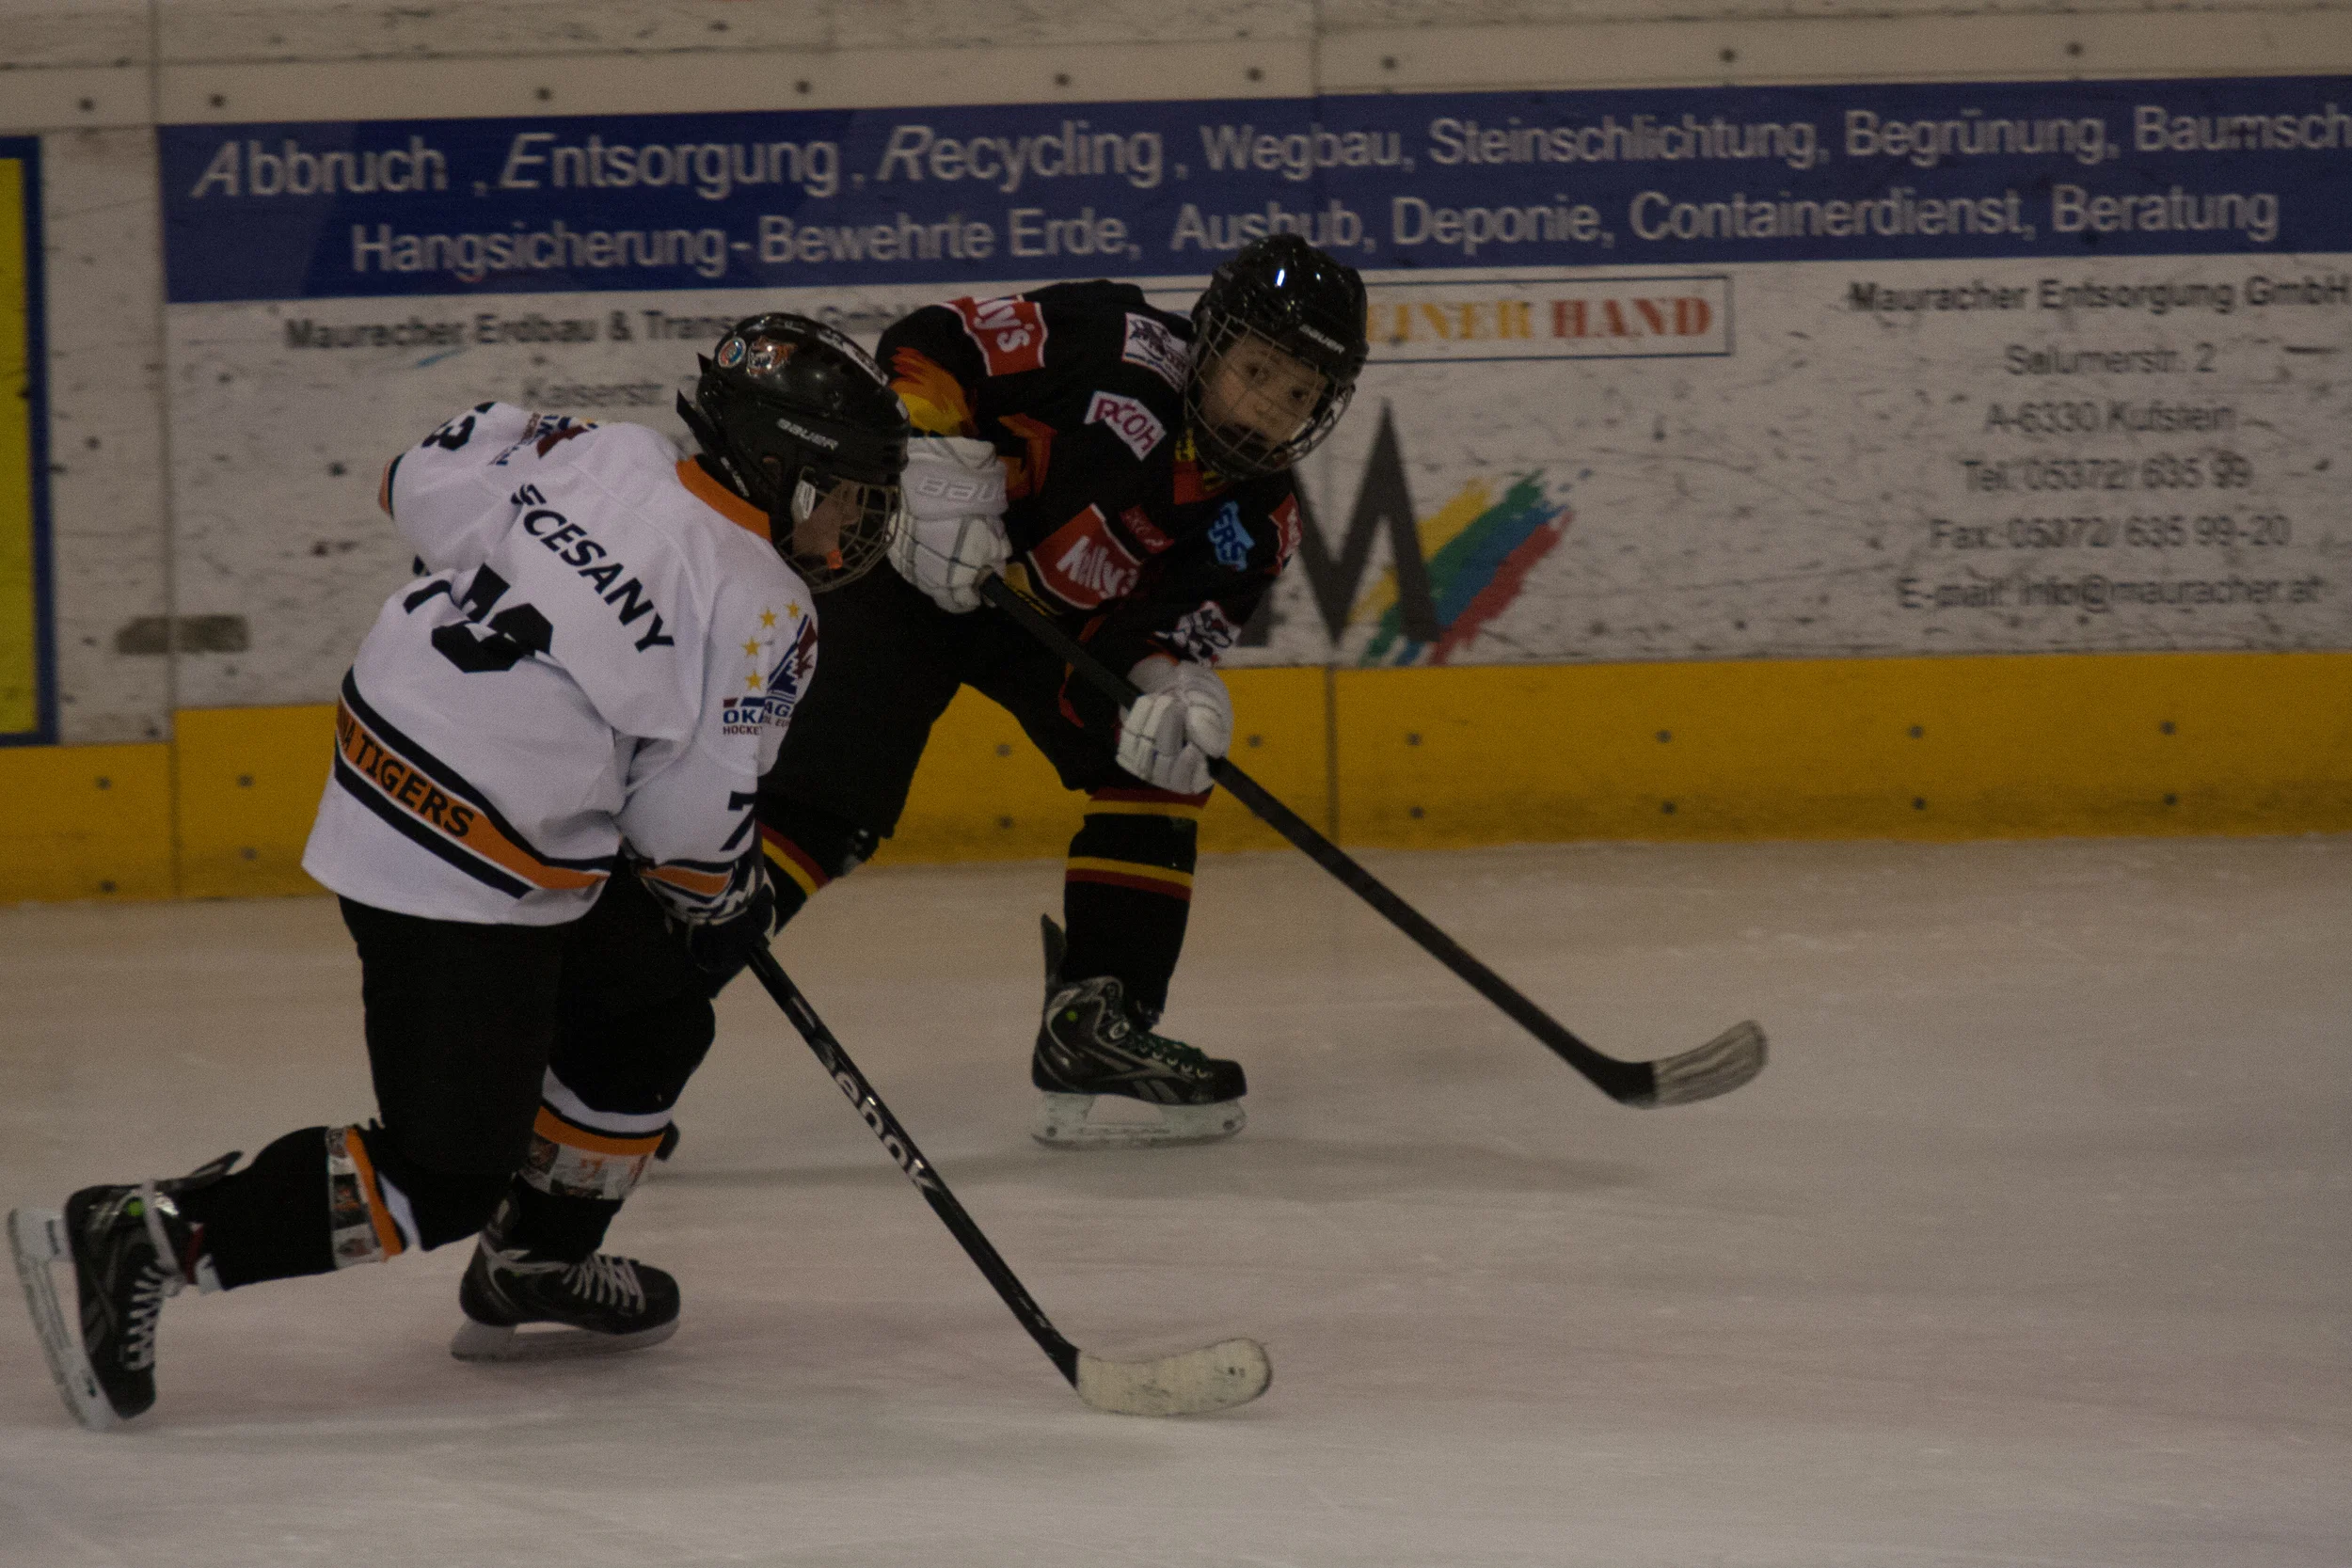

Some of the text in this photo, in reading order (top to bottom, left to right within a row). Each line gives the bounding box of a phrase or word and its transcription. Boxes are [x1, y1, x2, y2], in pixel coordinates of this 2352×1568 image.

[191, 135, 449, 198] Abbruch
[2051, 183, 2279, 244] Beratung
[1550, 295, 1712, 339] HAND
[355, 733, 475, 837] TIGERS
